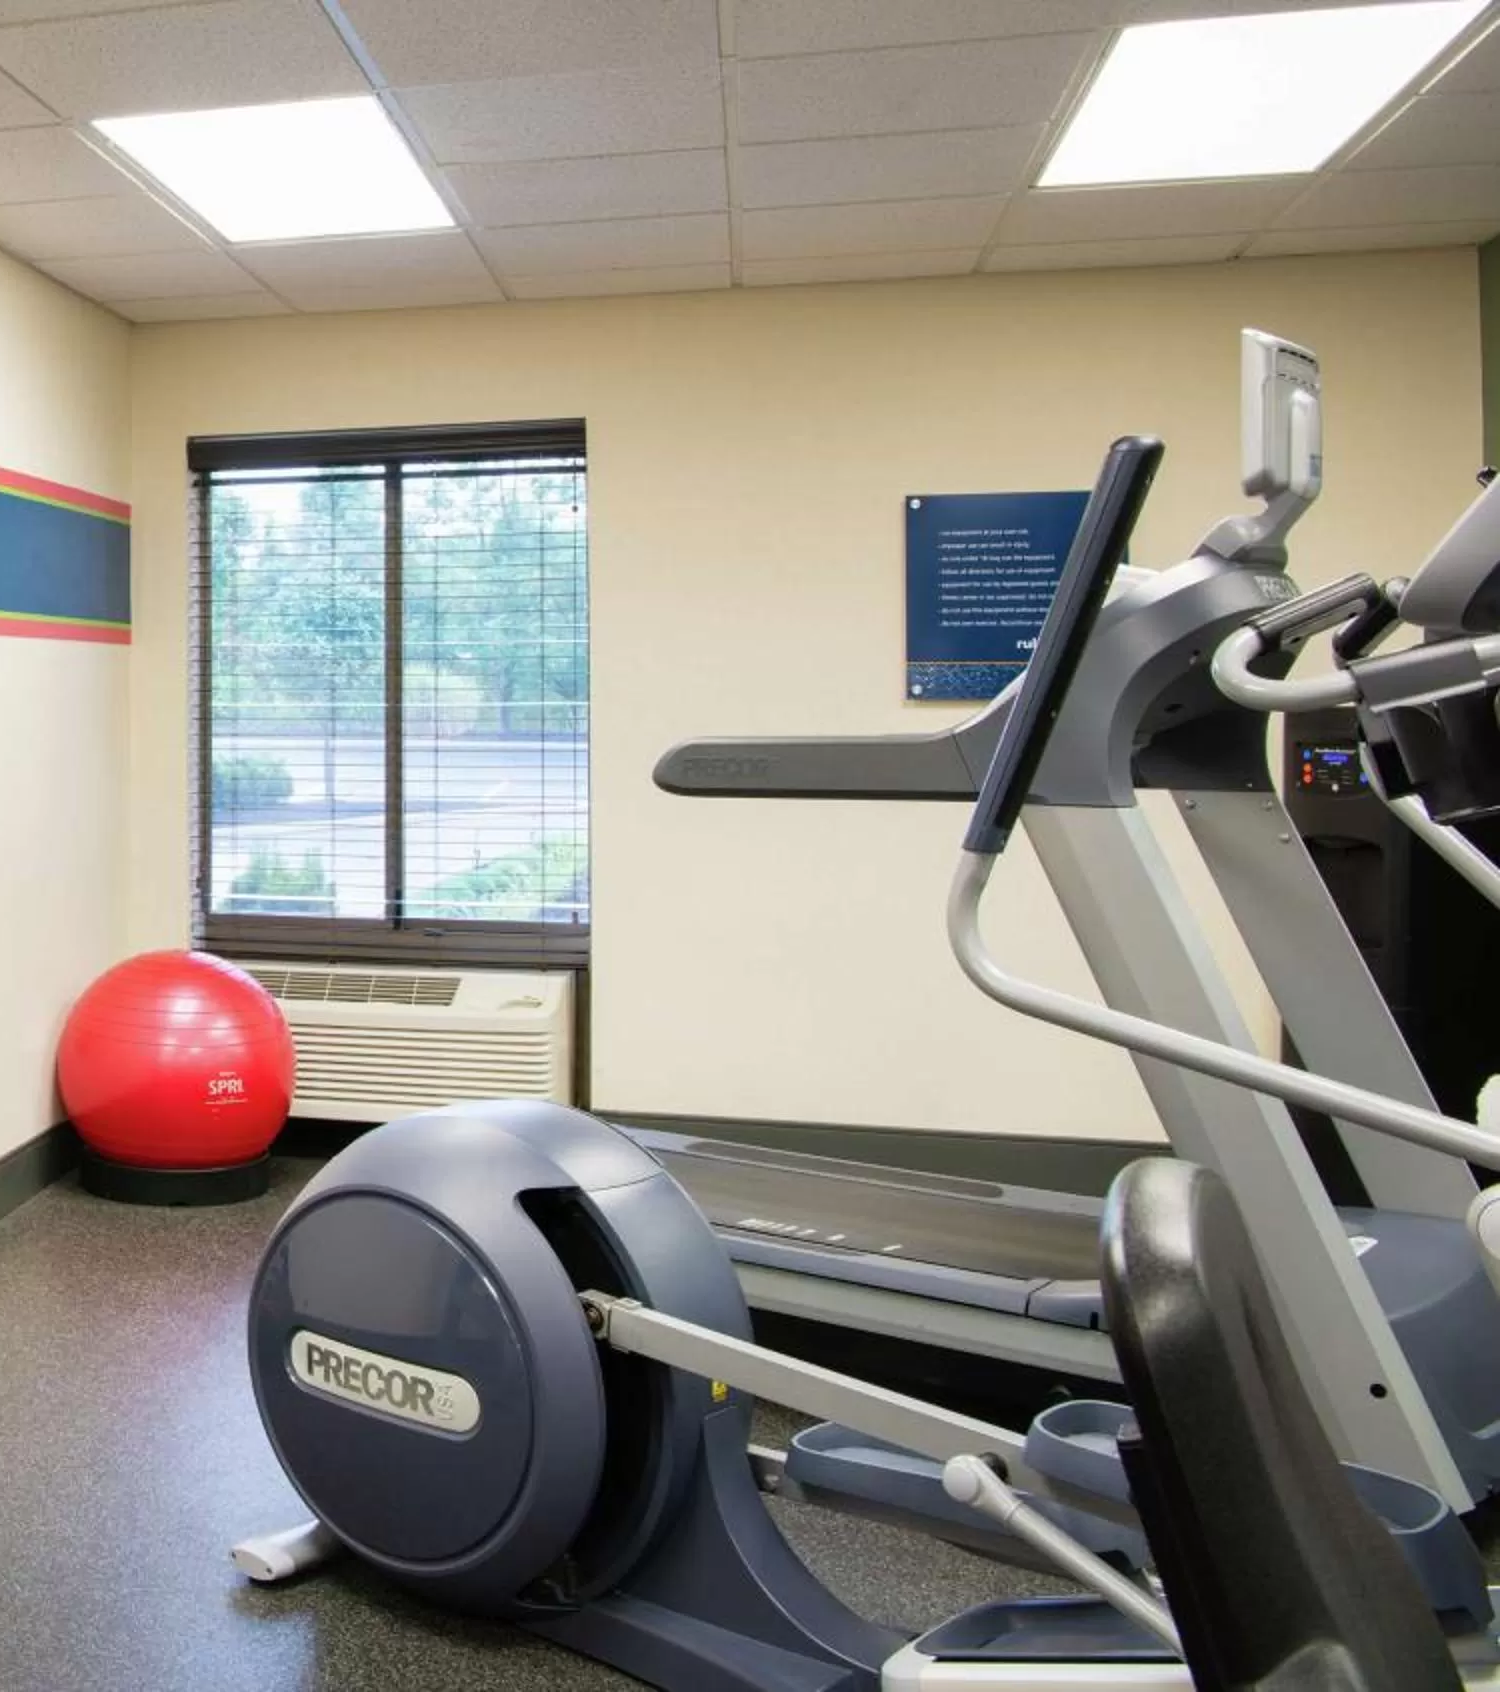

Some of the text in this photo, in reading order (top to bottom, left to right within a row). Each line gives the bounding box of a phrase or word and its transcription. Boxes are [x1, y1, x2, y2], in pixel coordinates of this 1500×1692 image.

[1017, 637, 1037, 649] rul
[208, 1079, 244, 1096] SPRI
[306, 1342, 453, 1421] PRECOR USA
